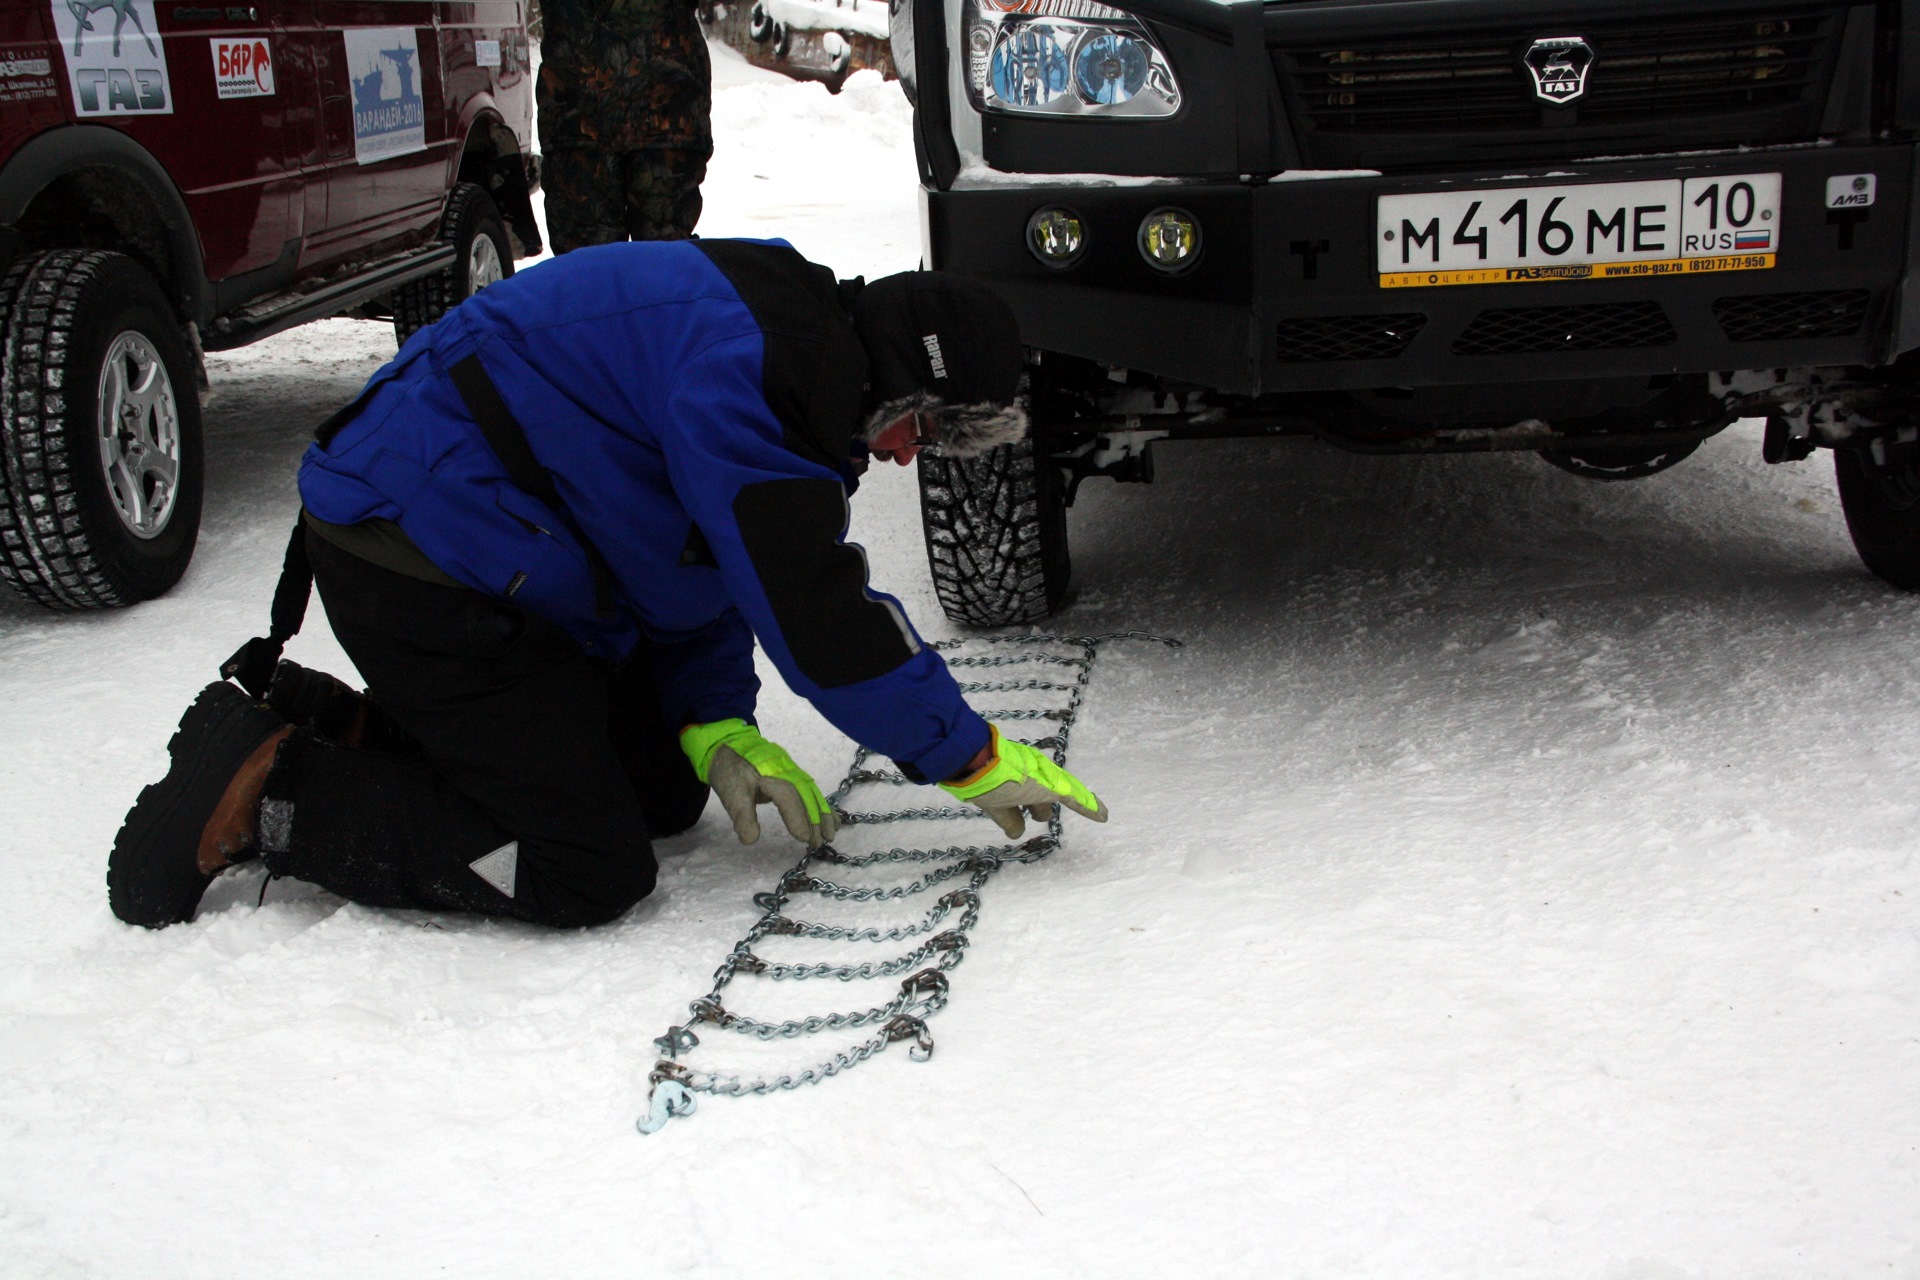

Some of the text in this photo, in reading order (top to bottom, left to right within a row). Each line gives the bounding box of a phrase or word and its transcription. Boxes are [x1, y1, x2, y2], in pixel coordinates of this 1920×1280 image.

[77, 68, 166, 112] ГАЗ
[1545, 82, 1575, 93] ГАЗ
[1694, 182, 1755, 230] 10
[1832, 194, 1868, 206] АМЗ
[1685, 233, 1732, 251] RUS
[1389, 273, 1500, 286] АВТОЦЕНТР
[1506, 268, 1540, 280] ГАЗ
[1605, 262, 1683, 277] www.sto-gaz.ru
[1689, 259, 1715, 272] (812)
[1717, 256, 1765, 270] 77-77-950
